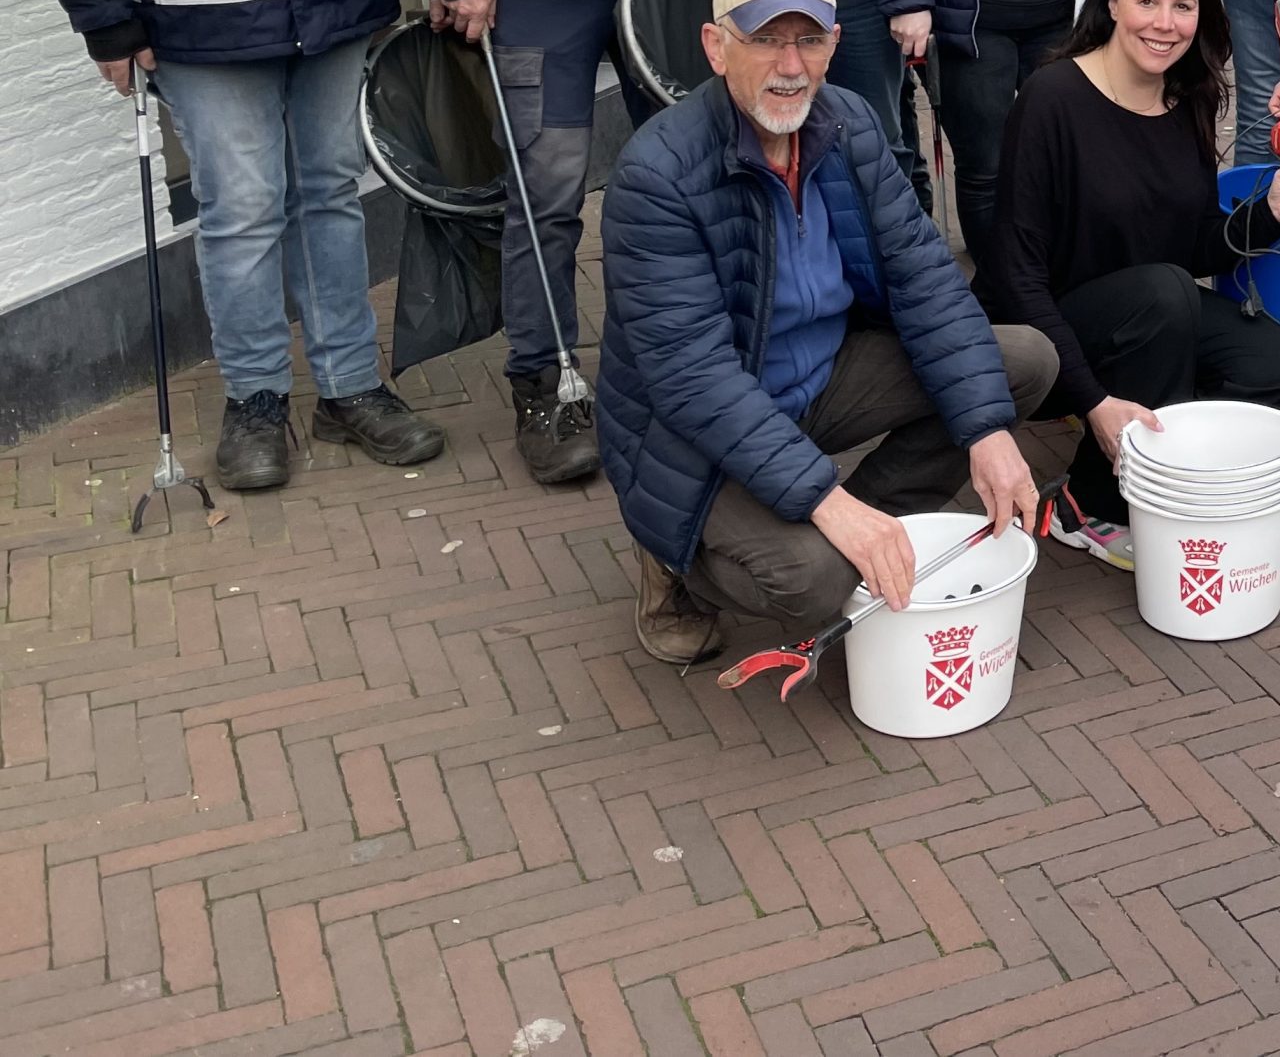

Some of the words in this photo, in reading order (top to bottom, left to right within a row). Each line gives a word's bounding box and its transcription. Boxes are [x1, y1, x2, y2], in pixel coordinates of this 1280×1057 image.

[1228, 562, 1271, 579] Gemeente
[1228, 569, 1279, 594] Wijchen
[979, 636, 1014, 662] Gemeente
